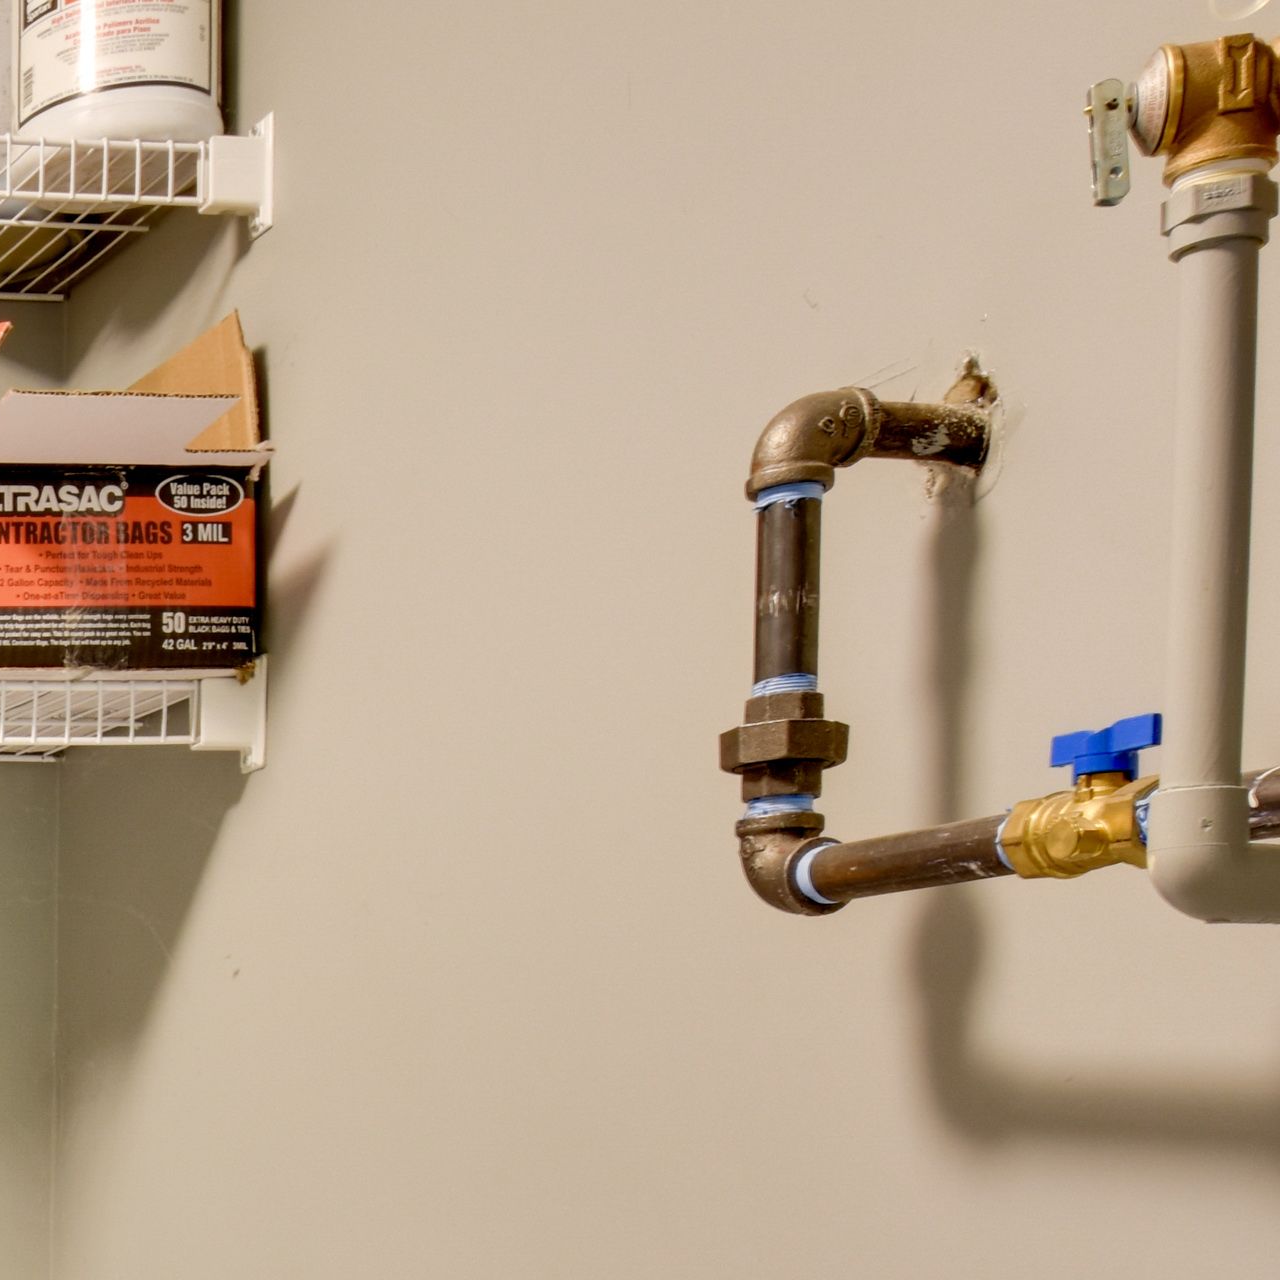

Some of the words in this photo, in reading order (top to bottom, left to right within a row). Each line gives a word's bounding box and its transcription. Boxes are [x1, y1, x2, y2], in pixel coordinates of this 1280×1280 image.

[170, 482, 200, 495] Value
[203, 482, 230, 495] Pack
[174, 497, 188, 508] 50
[190, 496, 226, 508] Inside!
[116, 521, 172, 545] BAGS
[183, 523, 193, 542] 3
[197, 523, 229, 542] MIL
[5, 565, 23, 573] Tear
[26, 565, 31, 573] &
[126, 565, 165, 573] Industrial
[168, 565, 203, 574] Strength
[37, 579, 74, 588] Capacity
[135, 578, 173, 587] Recycled
[175, 578, 212, 586] Materials
[138, 592, 160, 600] Great
[164, 592, 186, 600] Value
[162, 612, 185, 633] 50
[189, 616, 209, 624] EXTRA
[210, 616, 232, 624] HEAVY
[232, 616, 249, 624] DUTY
[237, 625, 251, 633] TIES
[162, 639, 174, 650] 42
[176, 639, 197, 650] GAL
